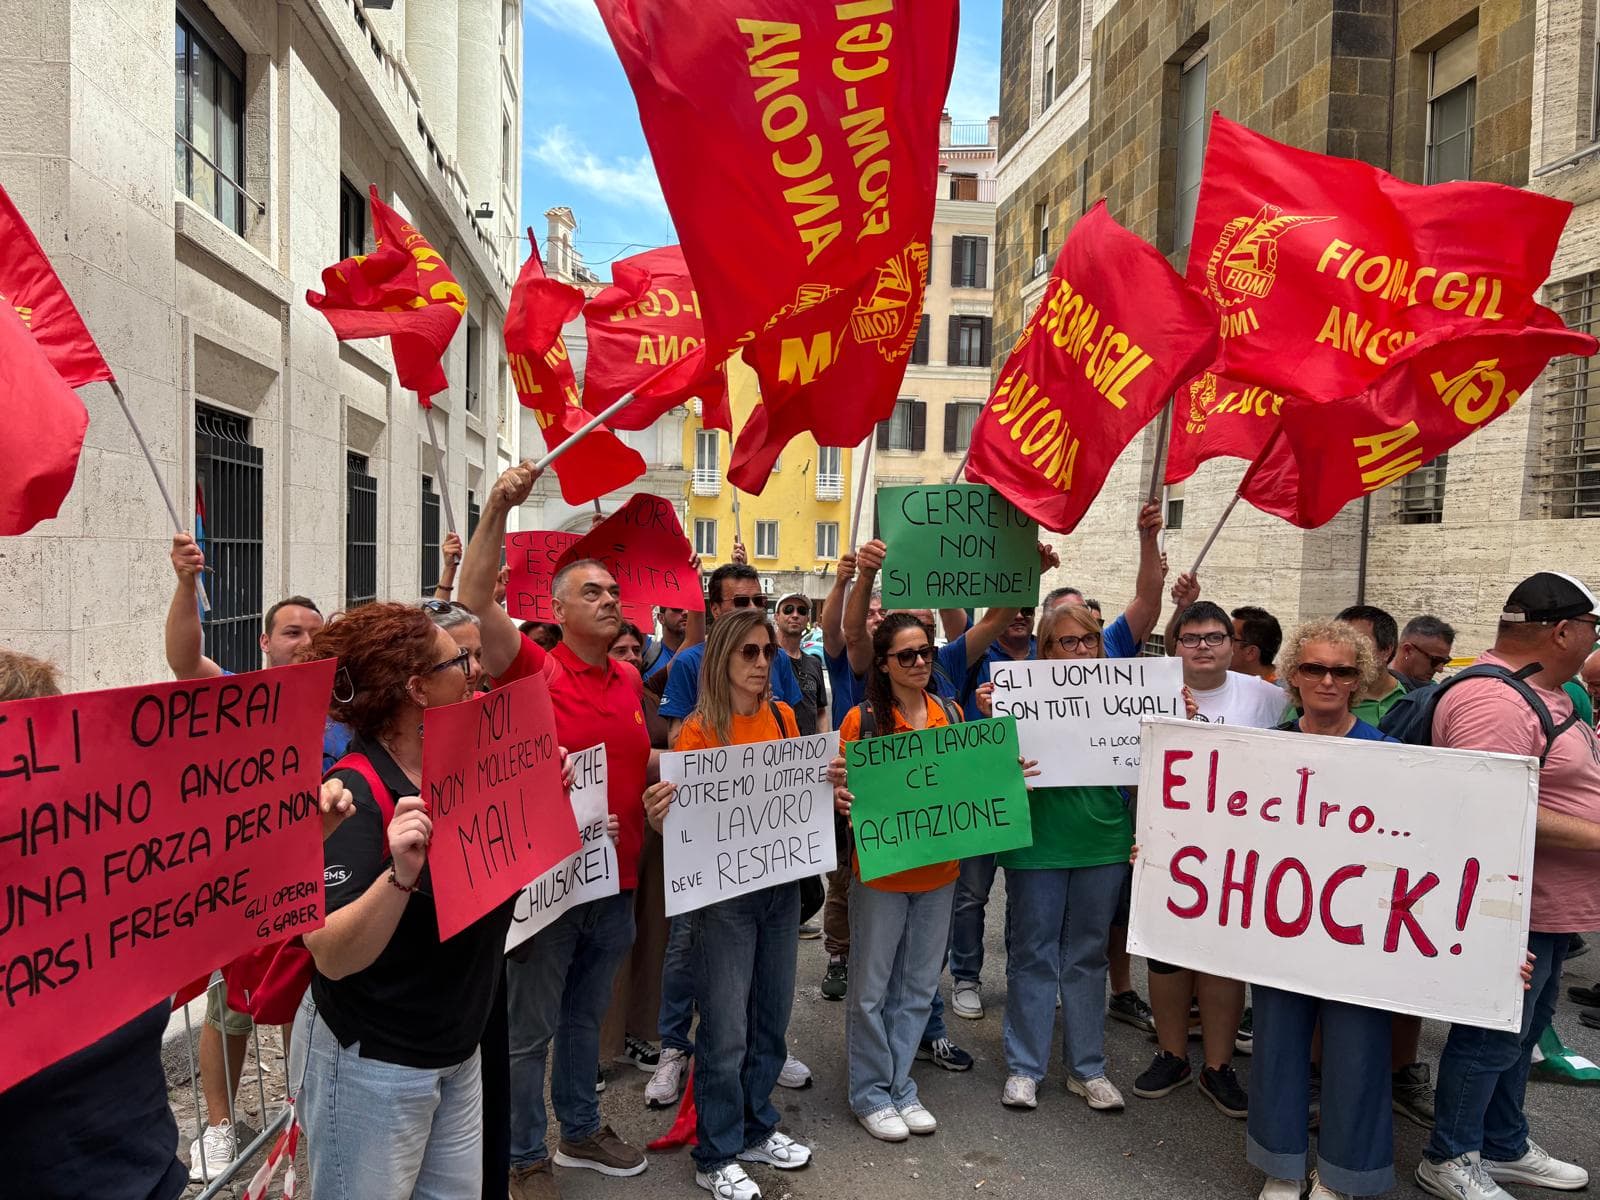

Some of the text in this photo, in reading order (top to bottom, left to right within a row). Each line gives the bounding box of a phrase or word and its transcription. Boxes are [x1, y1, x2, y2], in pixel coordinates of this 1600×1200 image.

[1225, 268, 1267, 295] FIOM
[1316, 238, 1504, 320] FIOM-CGIL
[940, 535, 996, 559] NON
[888, 567, 1033, 597] SI ARRENDE!
[994, 663, 1145, 691] GLI UOMINI
[130, 682, 281, 748] OPERAI
[995, 695, 1177, 720] SON TUTTI UGUALI
[684, 737, 828, 778] FINO A QUANDO
[852, 720, 1006, 768] SENZA LAVORO
[1090, 736, 1106, 747] LA
[181, 745, 300, 804] ANCORA
[431, 733, 553, 821] NON MOLLEREMO
[763, 764, 828, 792] LOTTARE
[1125, 757, 1141, 768] GU
[681, 789, 813, 843] IL LAVORO
[860, 797, 1011, 852] AGITAZIONE
[104, 827, 211, 896] FORZA
[225, 802, 271, 852] PER
[279, 785, 322, 830] NON
[671, 830, 822, 893] DEVE RESTARE
[109, 868, 251, 959] FREGARE
[244, 880, 319, 920] GLI OPERAI
[274, 904, 319, 932] GABER
